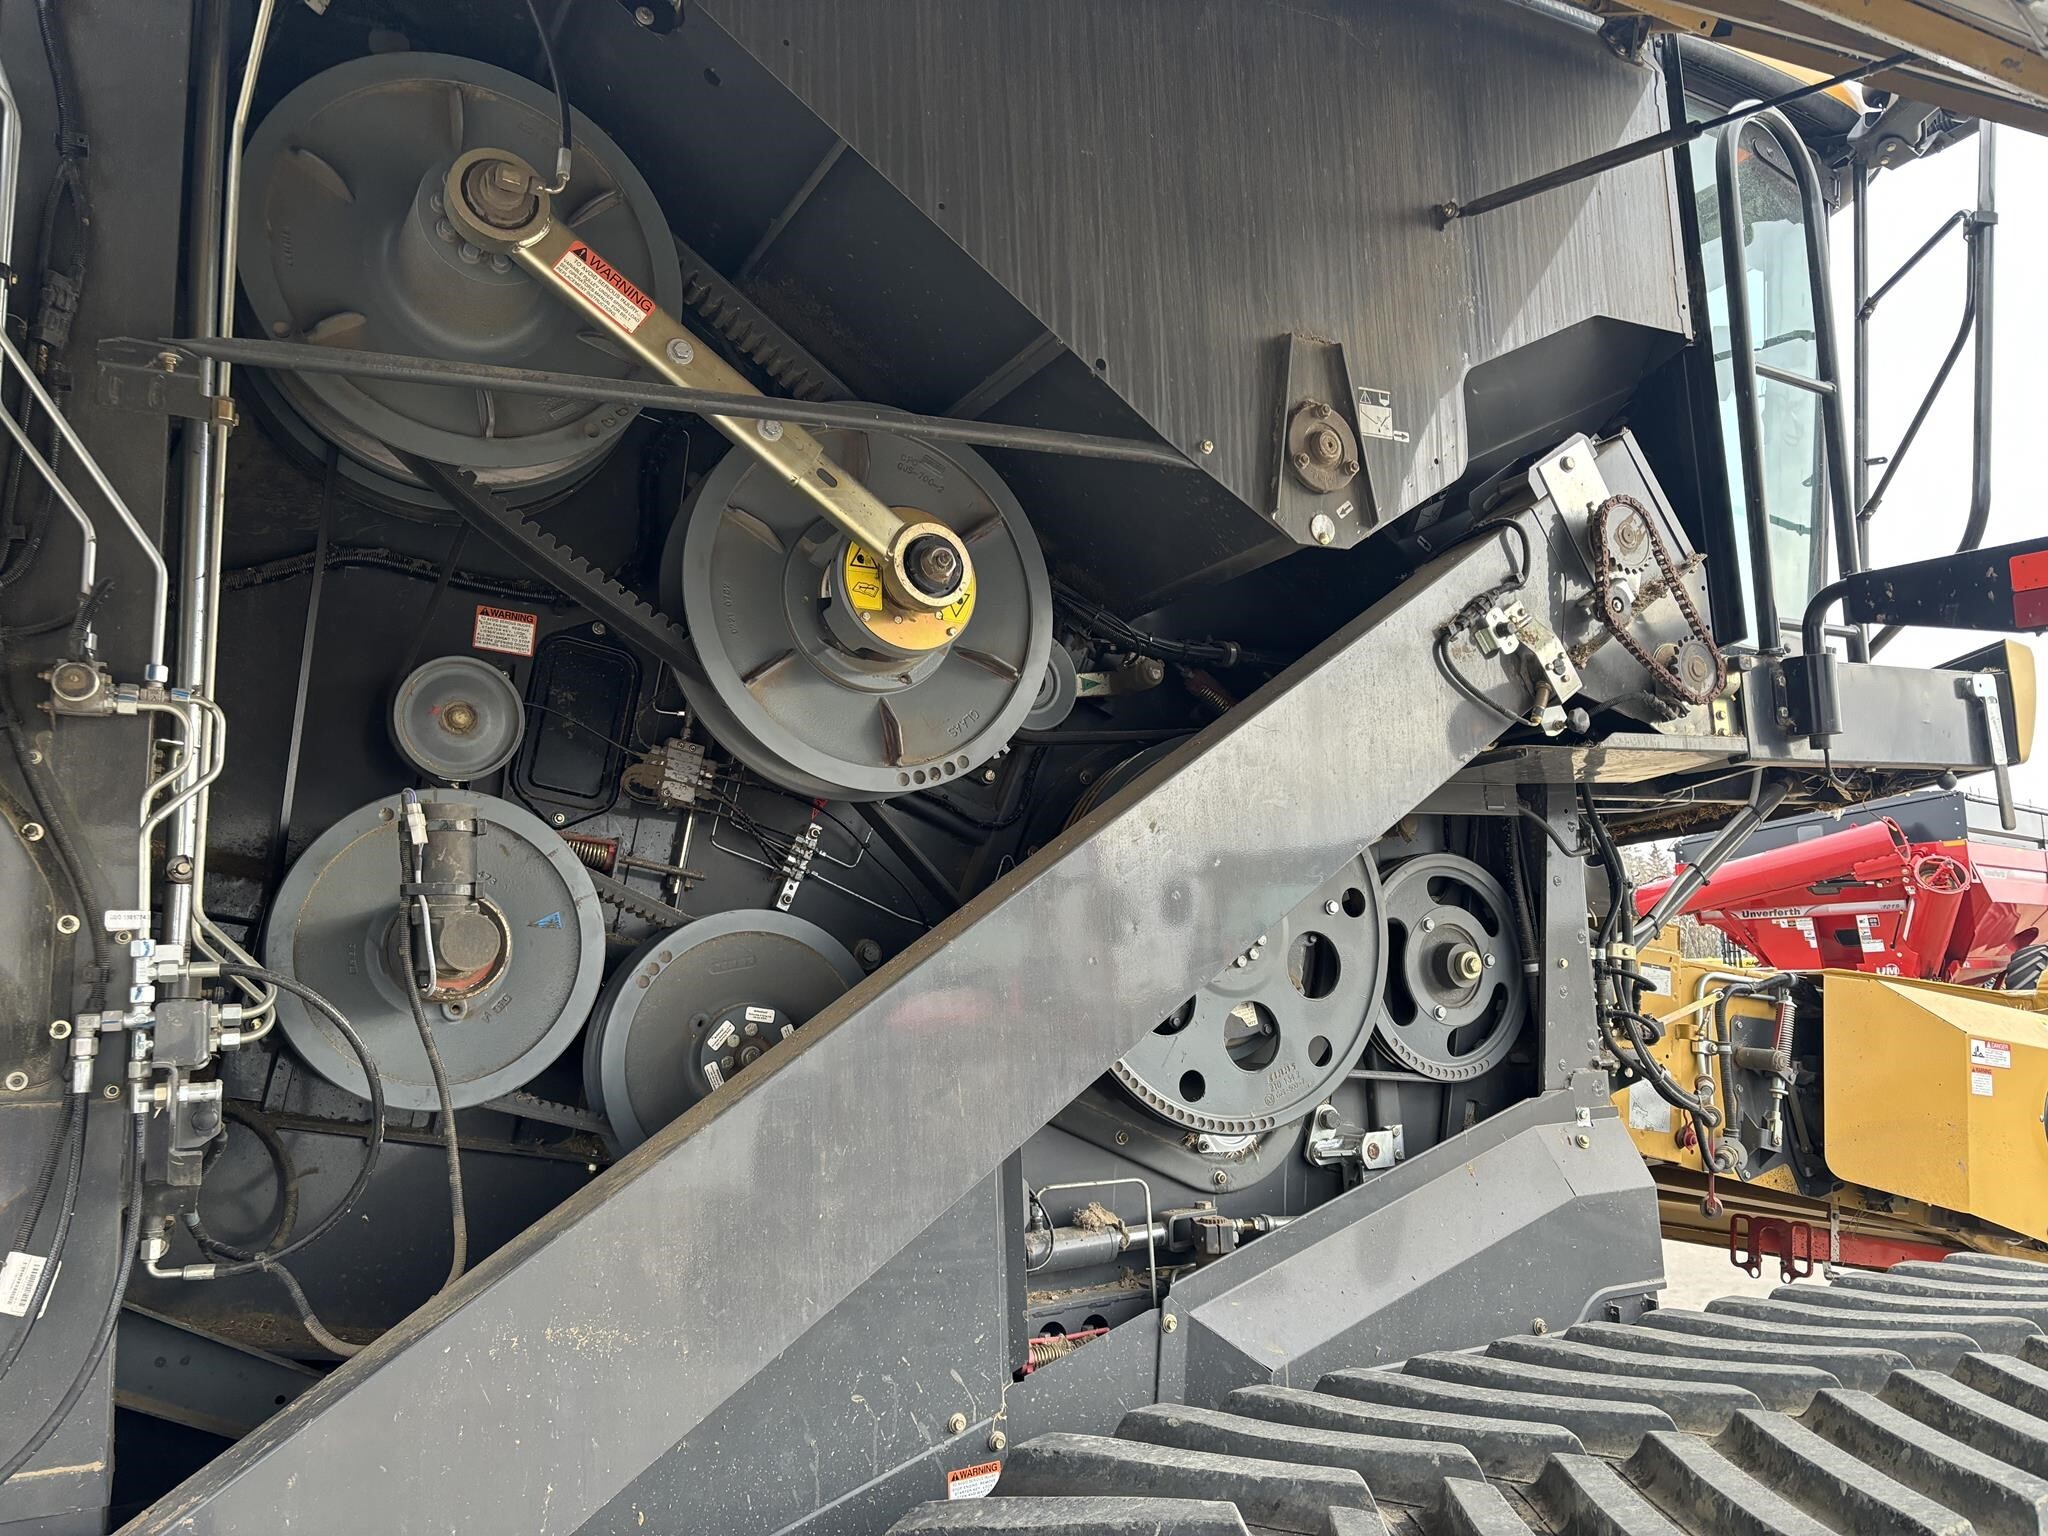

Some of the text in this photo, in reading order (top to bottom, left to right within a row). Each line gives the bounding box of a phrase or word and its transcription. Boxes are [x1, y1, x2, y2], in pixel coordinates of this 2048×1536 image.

[558, 262, 569, 271] SEE
[593, 290, 611, 306] MANUAL
[610, 303, 621, 313] FOR
[619, 311, 631, 322] BELT
[572, 258, 582, 267] TO
[580, 265, 598, 281] AVOID
[596, 278, 621, 299] SERIOUS
[581, 274, 599, 289] PULLEY
[597, 286, 614, 301] UNDER
[612, 298, 629, 314] SPRING
[590, 256, 652, 312] WARNING
[490, 608, 534, 622] WARNING
[947, 709, 980, 737] CLAAS
[960, 1463, 998, 1480] WARNING
